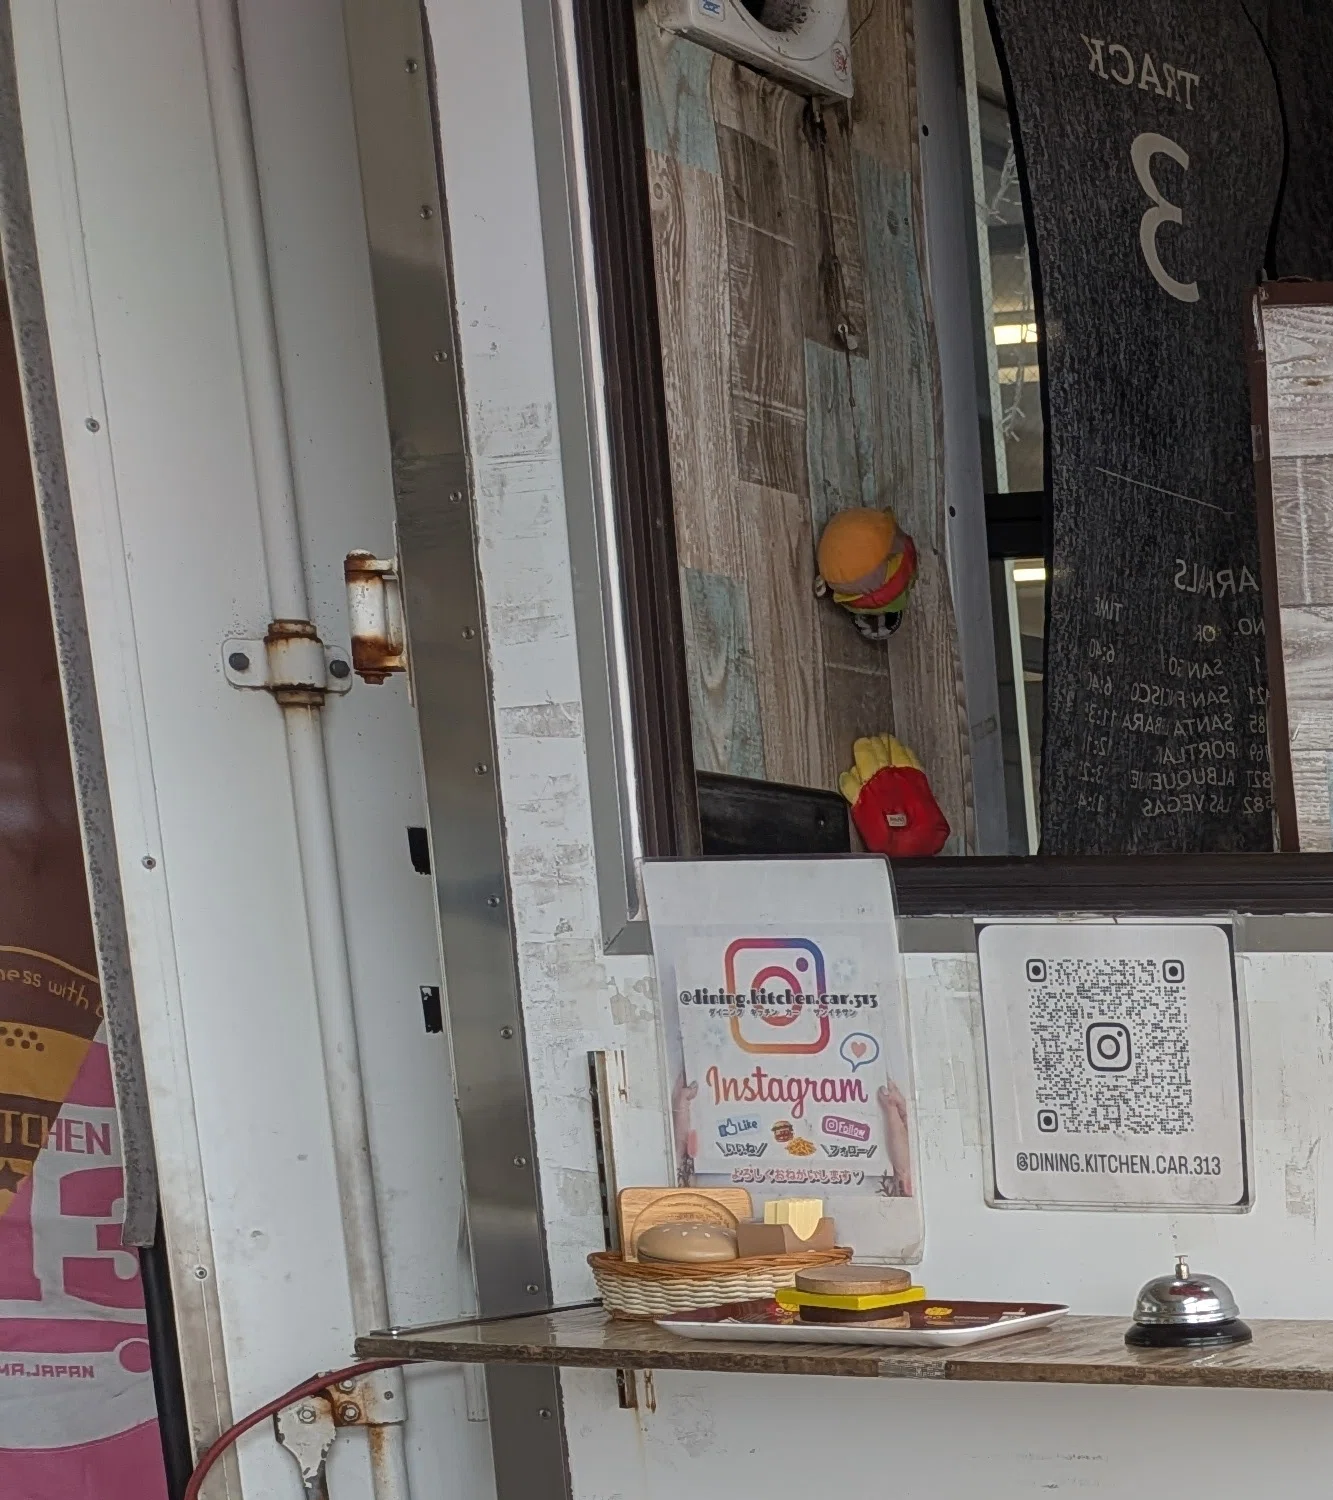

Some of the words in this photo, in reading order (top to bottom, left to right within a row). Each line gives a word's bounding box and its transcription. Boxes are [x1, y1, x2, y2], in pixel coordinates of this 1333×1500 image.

[679, 987, 879, 1009] @dining.kitchen.car.313
[706, 1065, 869, 1119] Instagram
[738, 1120, 758, 1131] Like
[838, 1120, 867, 1139] Follow
[1016, 1152, 1222, 1175] @DINING.KITCHEN.CAR.313
